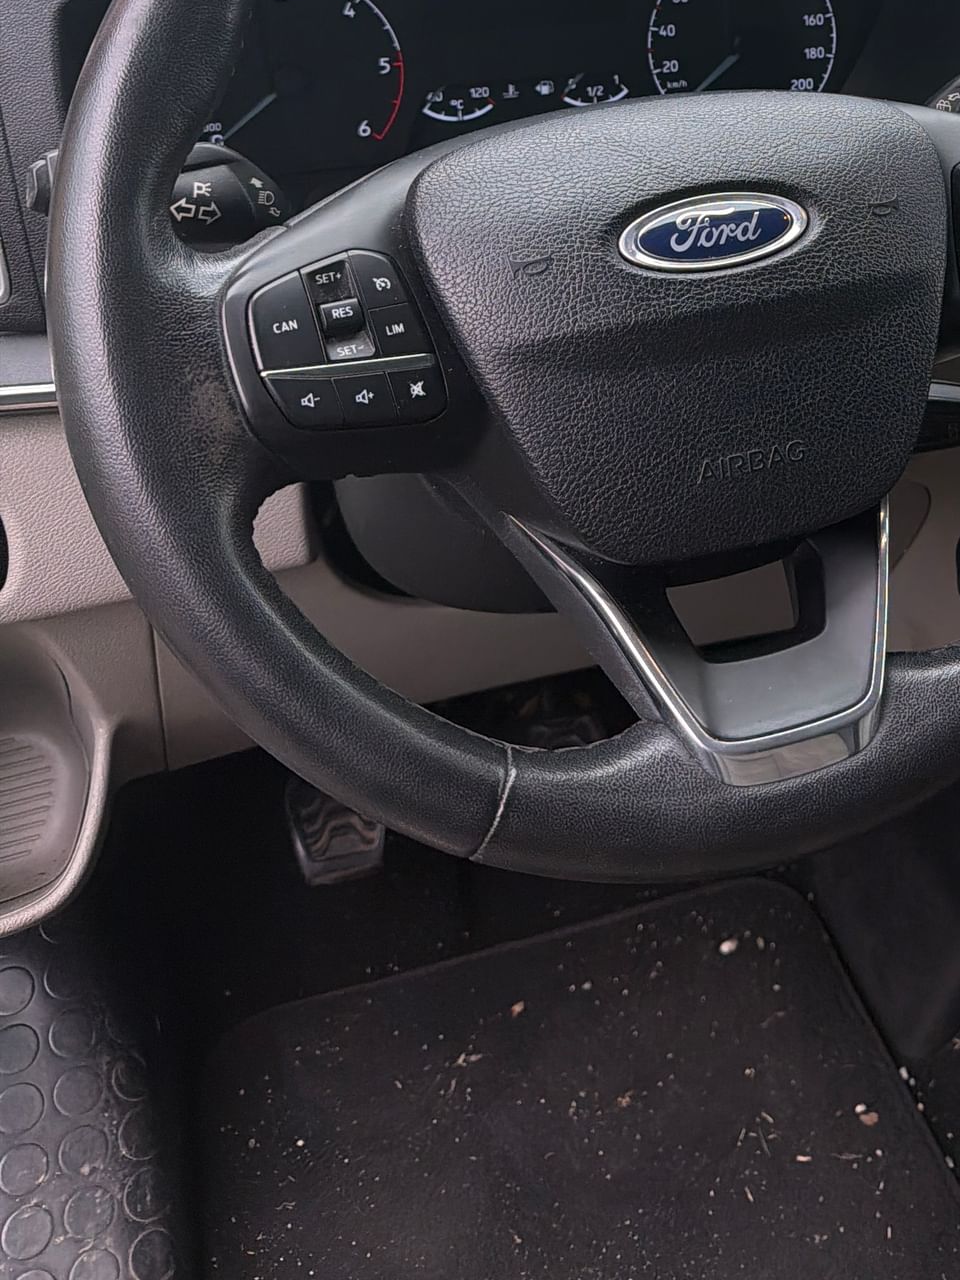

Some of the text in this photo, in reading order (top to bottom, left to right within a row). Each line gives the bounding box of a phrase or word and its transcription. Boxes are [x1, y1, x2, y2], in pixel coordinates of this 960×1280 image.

[343, 1, 356, 18] 4
[803, 13, 824, 26] 160
[659, 24, 676, 37] 40
[804, 46, 825, 60] 180
[378, 57, 391, 74] 5
[662, 60, 679, 73] 20
[613, 74, 620, 85] 1
[666, 80, 688, 89] km/h
[790, 77, 814, 91] 200
[470, 86, 490, 99] 120
[586, 85, 604, 97] 1/2
[357, 120, 372, 137] 6
[670, 207, 761, 253] Ford
[314, 272, 342, 285] SET+
[331, 306, 354, 320] RES
[273, 319, 298, 335] CAN
[385, 323, 405, 336] LIM
[698, 439, 805, 484] AIRBAG
